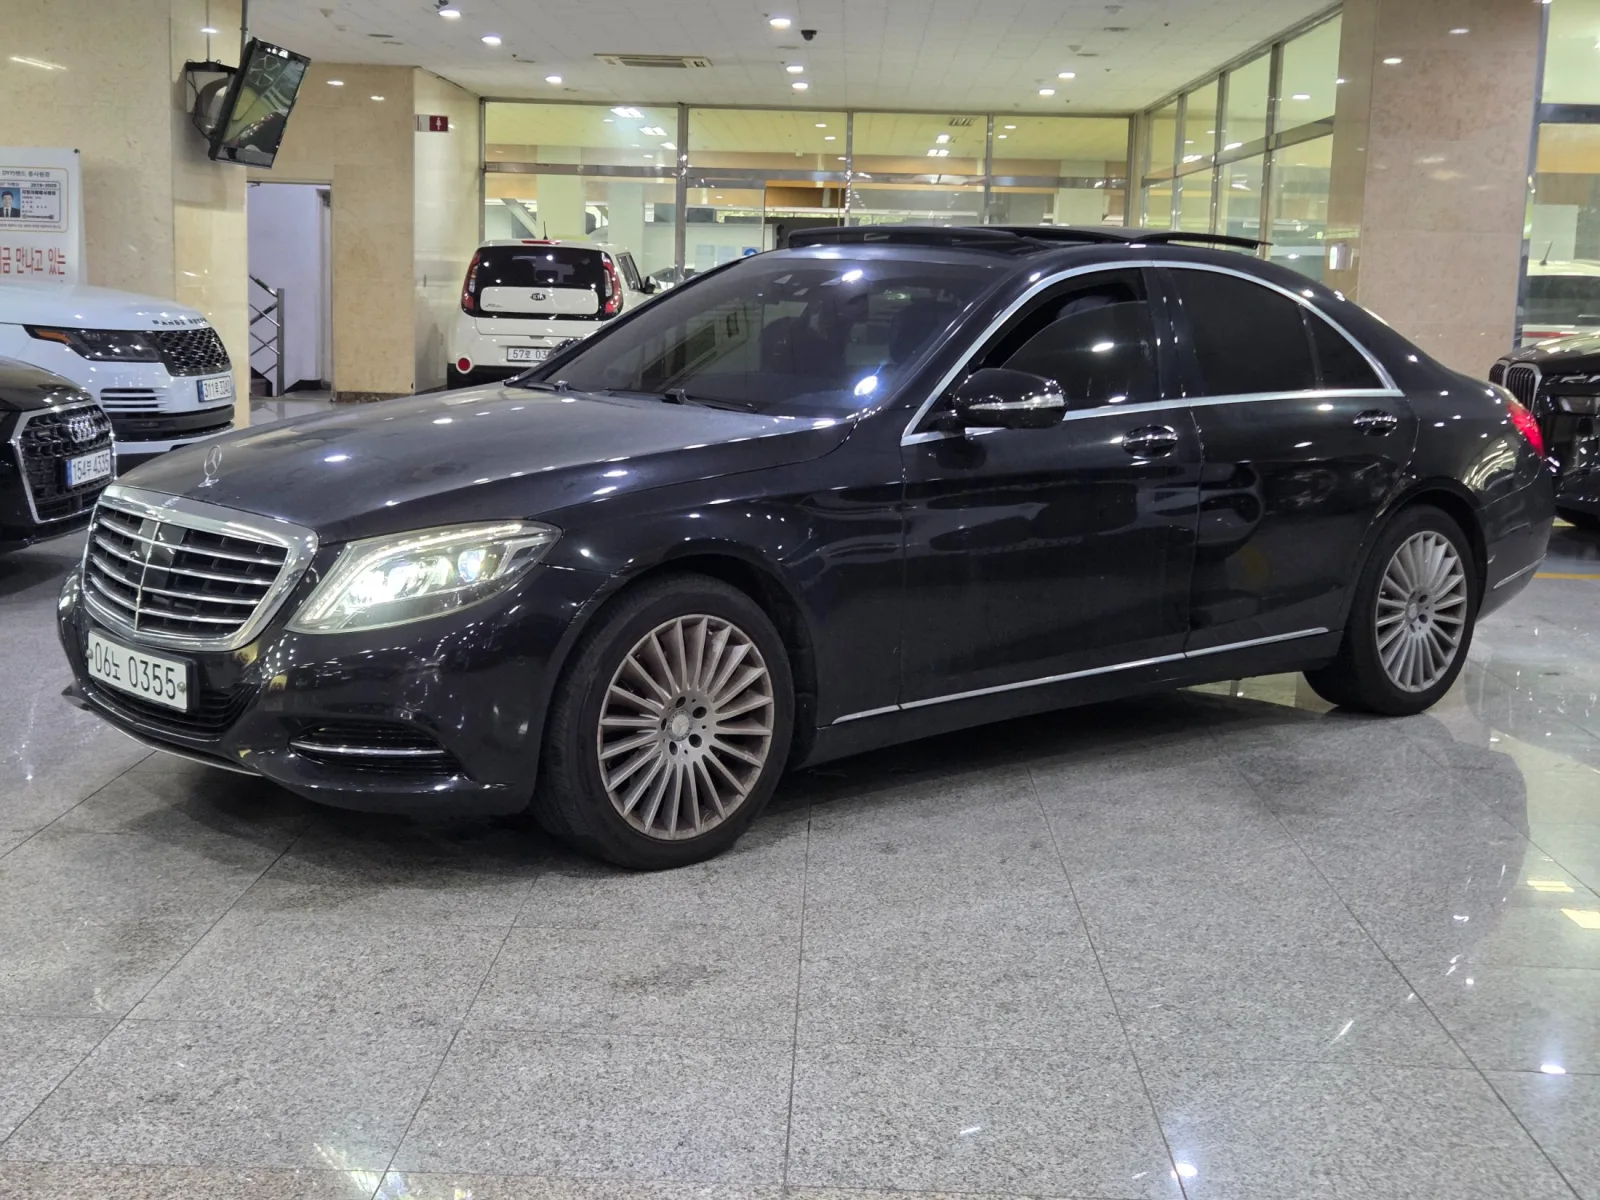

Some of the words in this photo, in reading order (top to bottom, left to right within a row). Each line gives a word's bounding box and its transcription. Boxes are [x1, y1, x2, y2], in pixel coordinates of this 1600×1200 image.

[16, 246, 43, 275] 만나고
[48, 247, 66, 275] 있는
[512, 349, 532, 360] 57로
[73, 459, 92, 481] 154부
[95, 642, 121, 682] 06노
[128, 656, 176, 700] 0355
